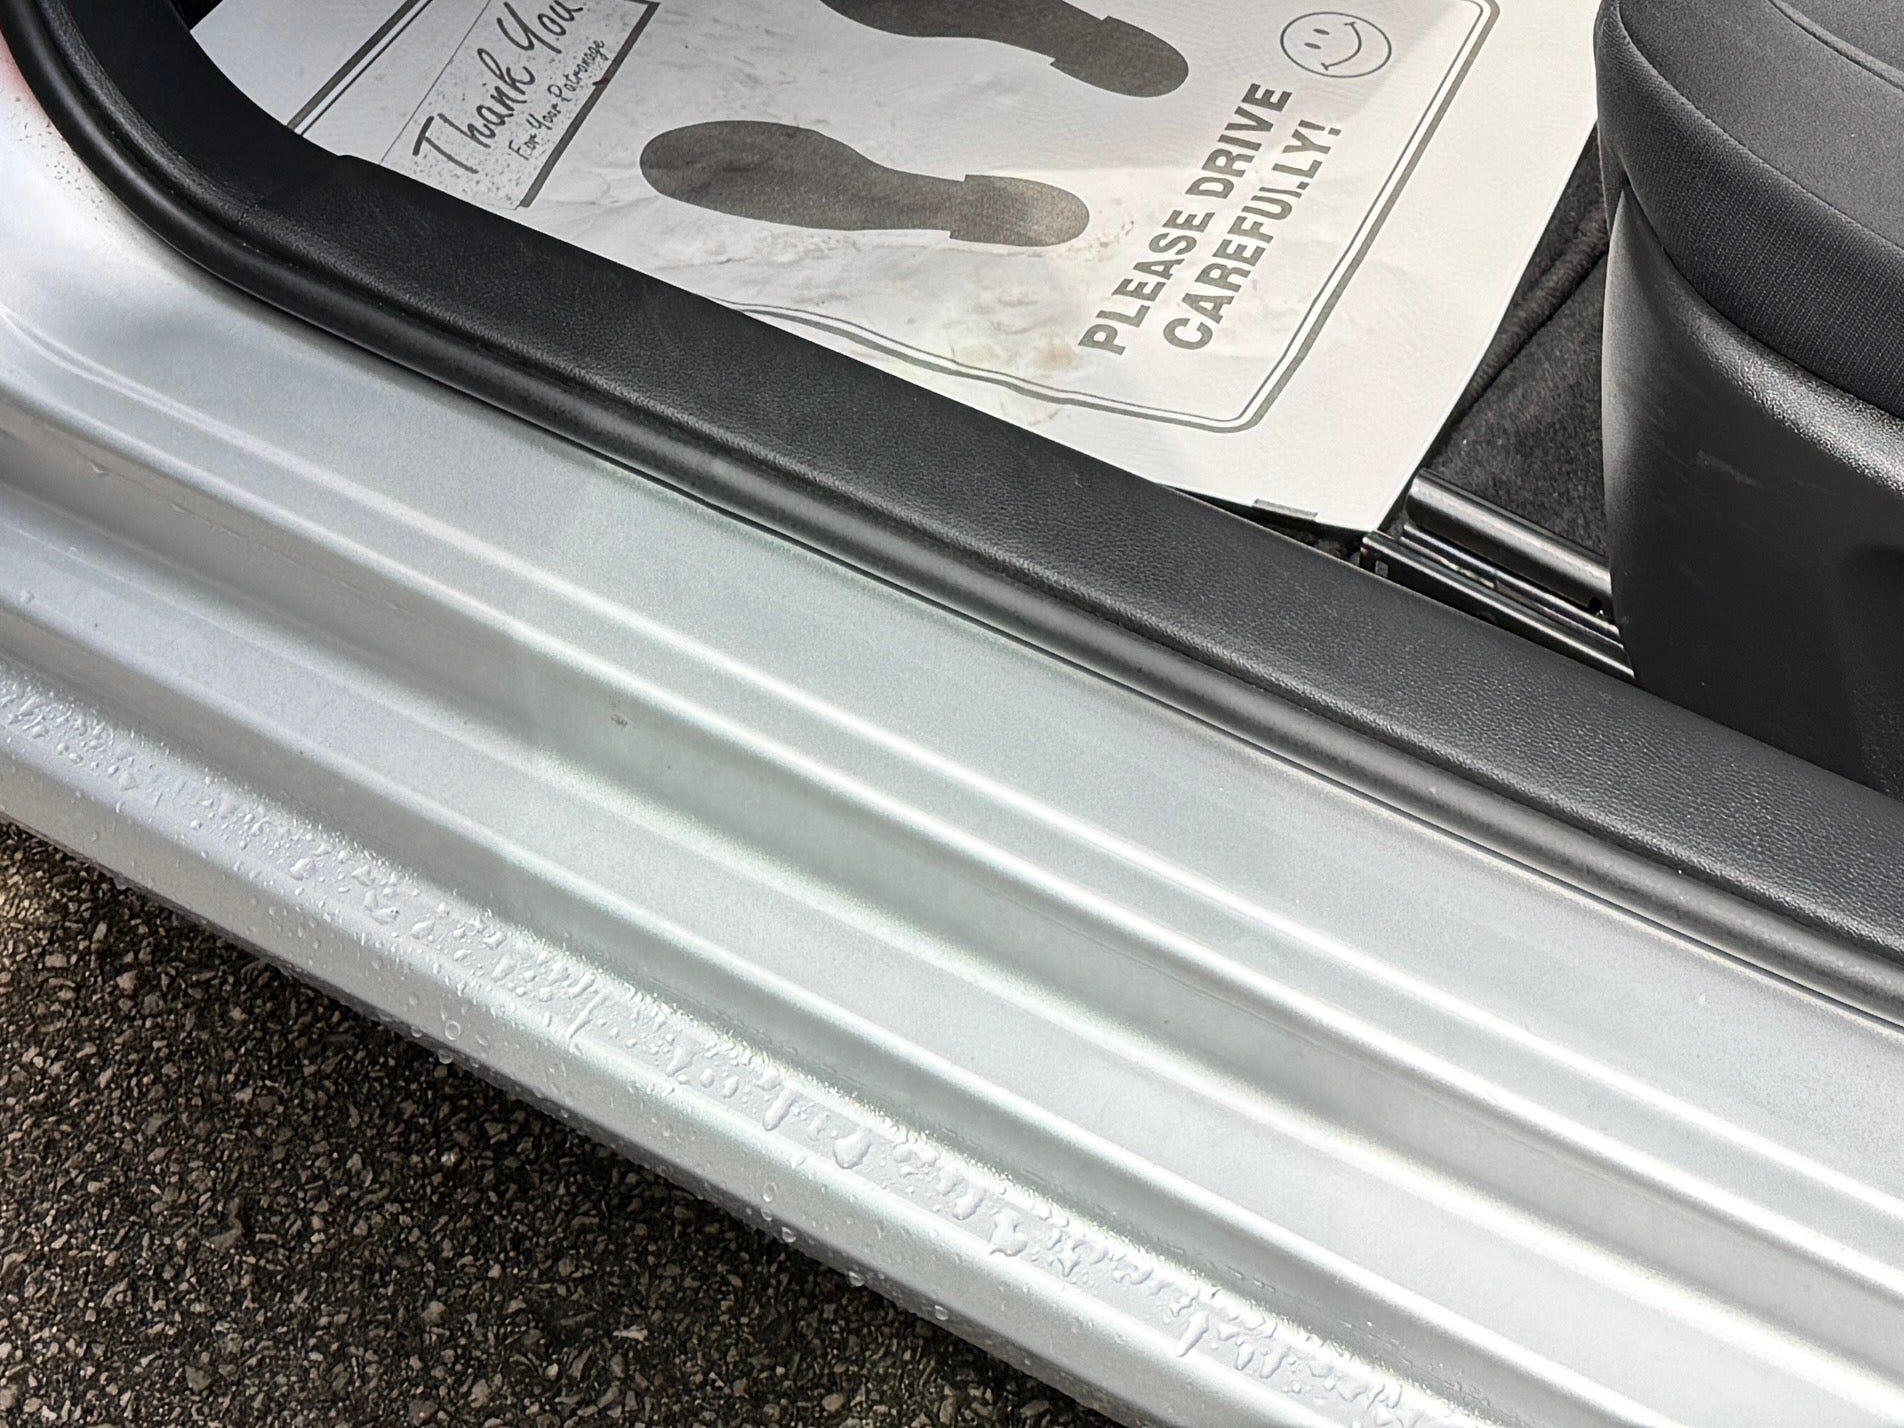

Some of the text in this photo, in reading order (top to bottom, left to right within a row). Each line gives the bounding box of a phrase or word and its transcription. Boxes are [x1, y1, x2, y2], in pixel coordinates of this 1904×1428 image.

[412, 47, 536, 175] Thank
[508, 39, 606, 161] For Your Patronage
[1078, 82, 1293, 356] PLEASE DRIVE
[1162, 119, 1342, 351] CAREFULLY!
